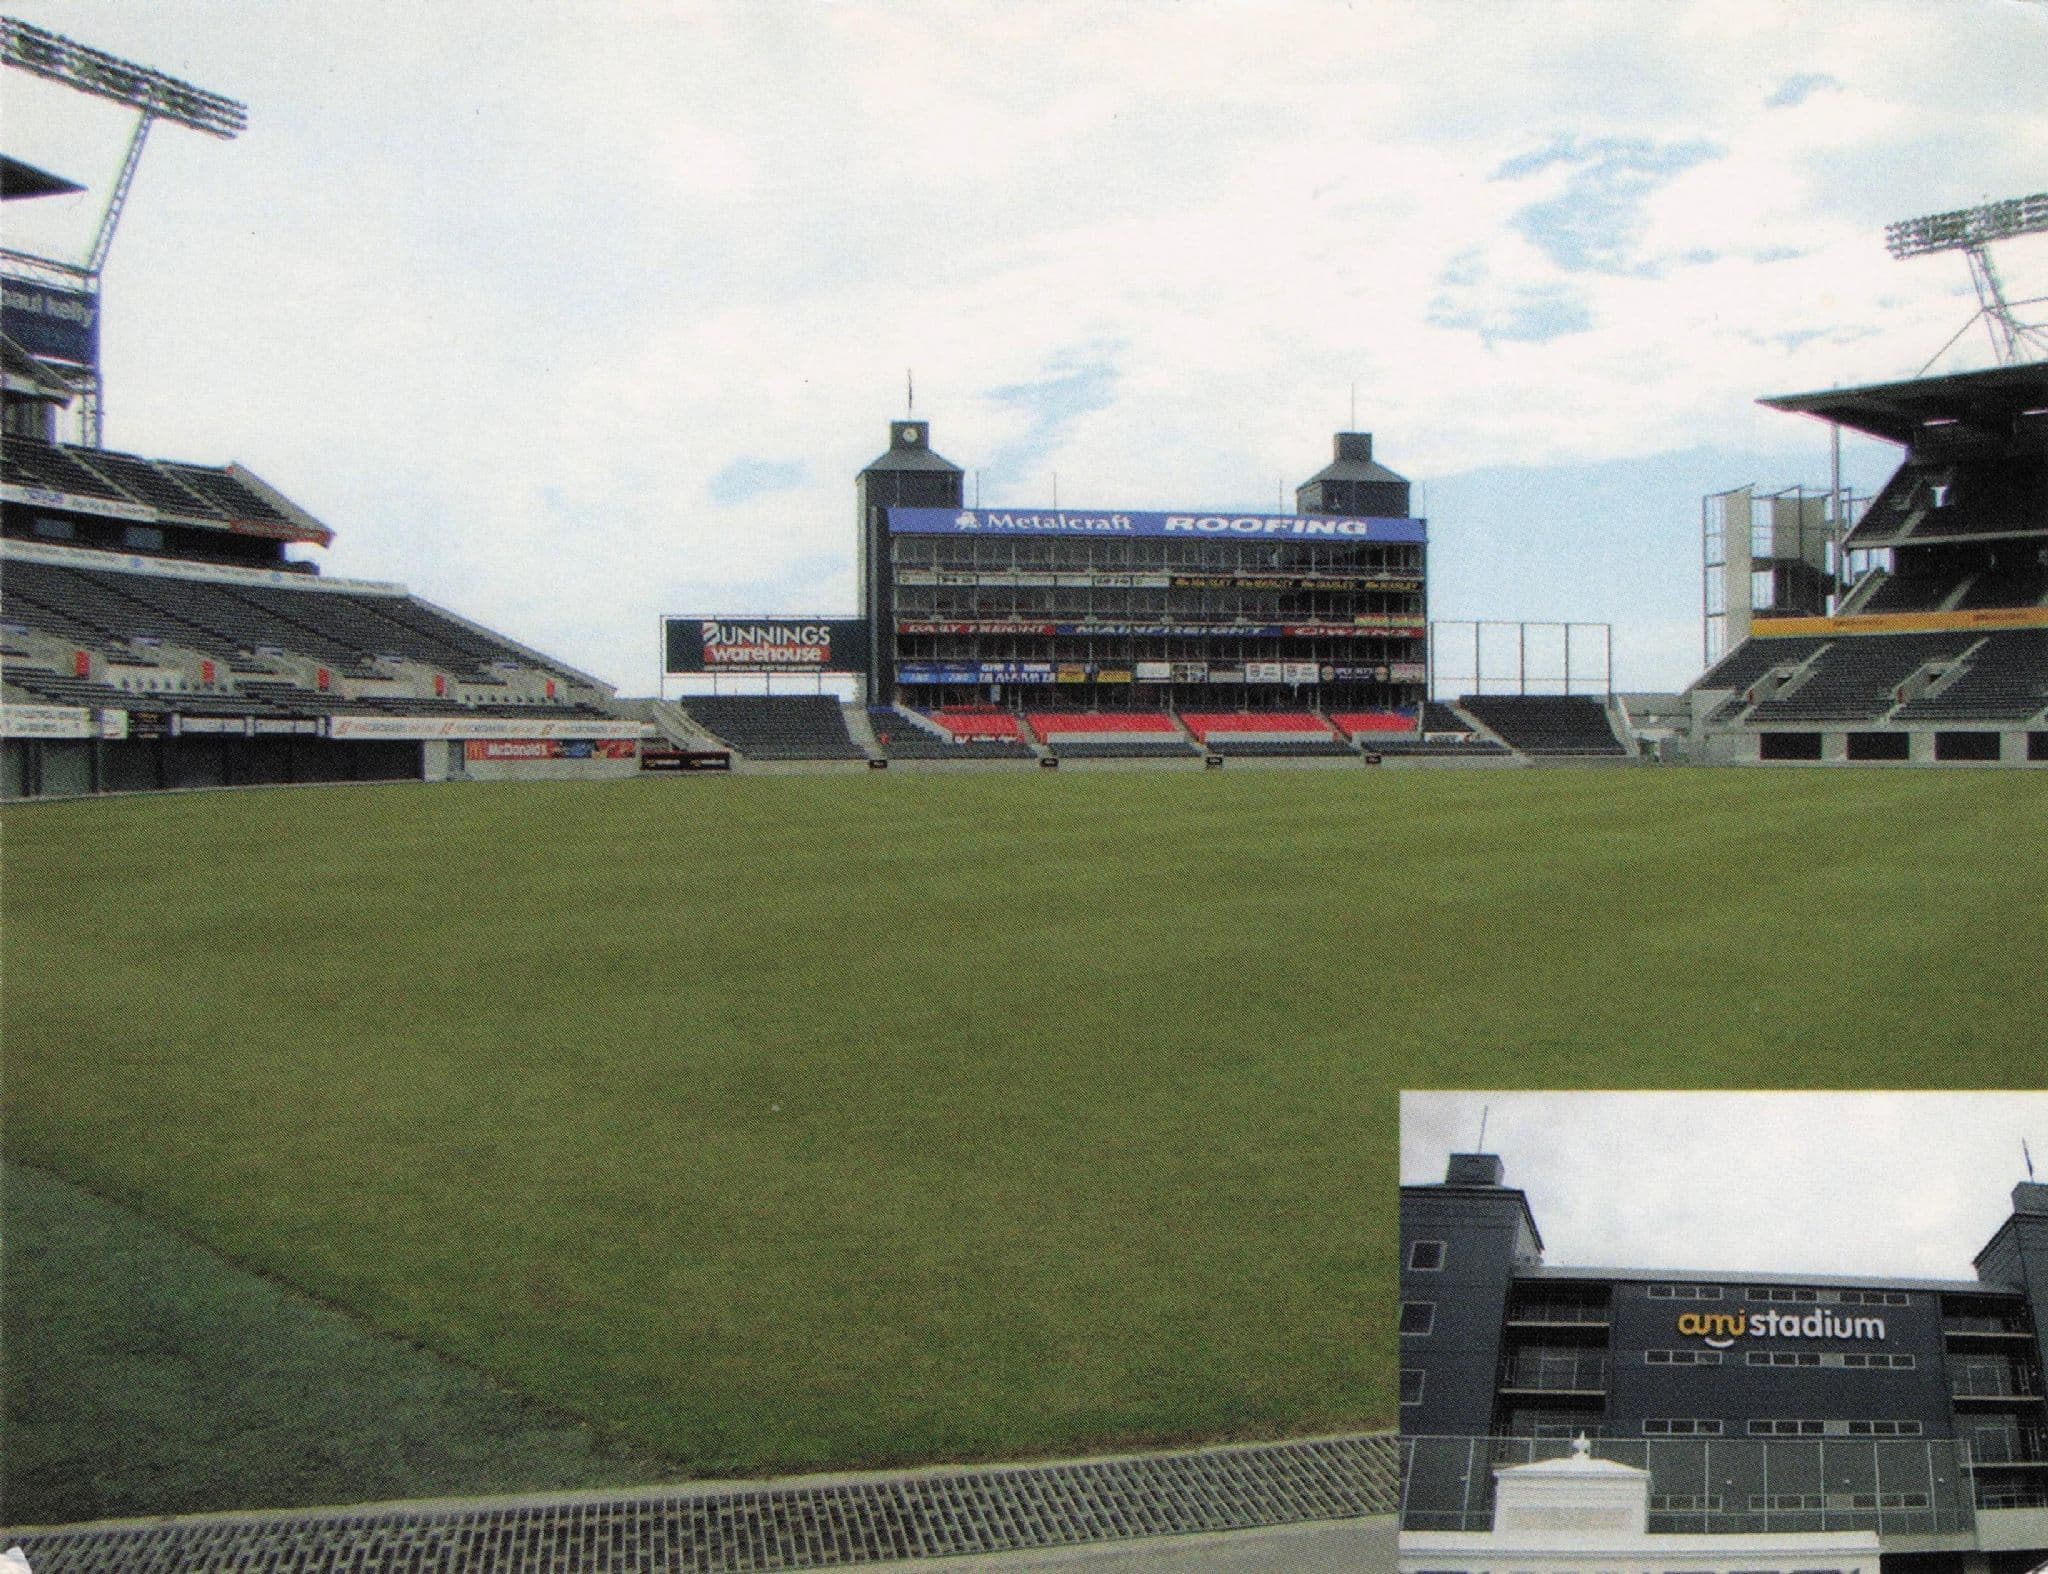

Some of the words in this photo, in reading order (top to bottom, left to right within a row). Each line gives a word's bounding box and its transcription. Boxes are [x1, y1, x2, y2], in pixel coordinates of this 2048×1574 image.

[987, 513, 1133, 531] Metalcraft
[1164, 516, 1368, 535] ROOFING
[702, 622, 831, 646] BUNNINGS
[712, 641, 823, 663] warehouse
[487, 743, 548, 756] McDonald's
[1678, 1307, 1746, 1336] ami
[1749, 1308, 1886, 1340] stadium
